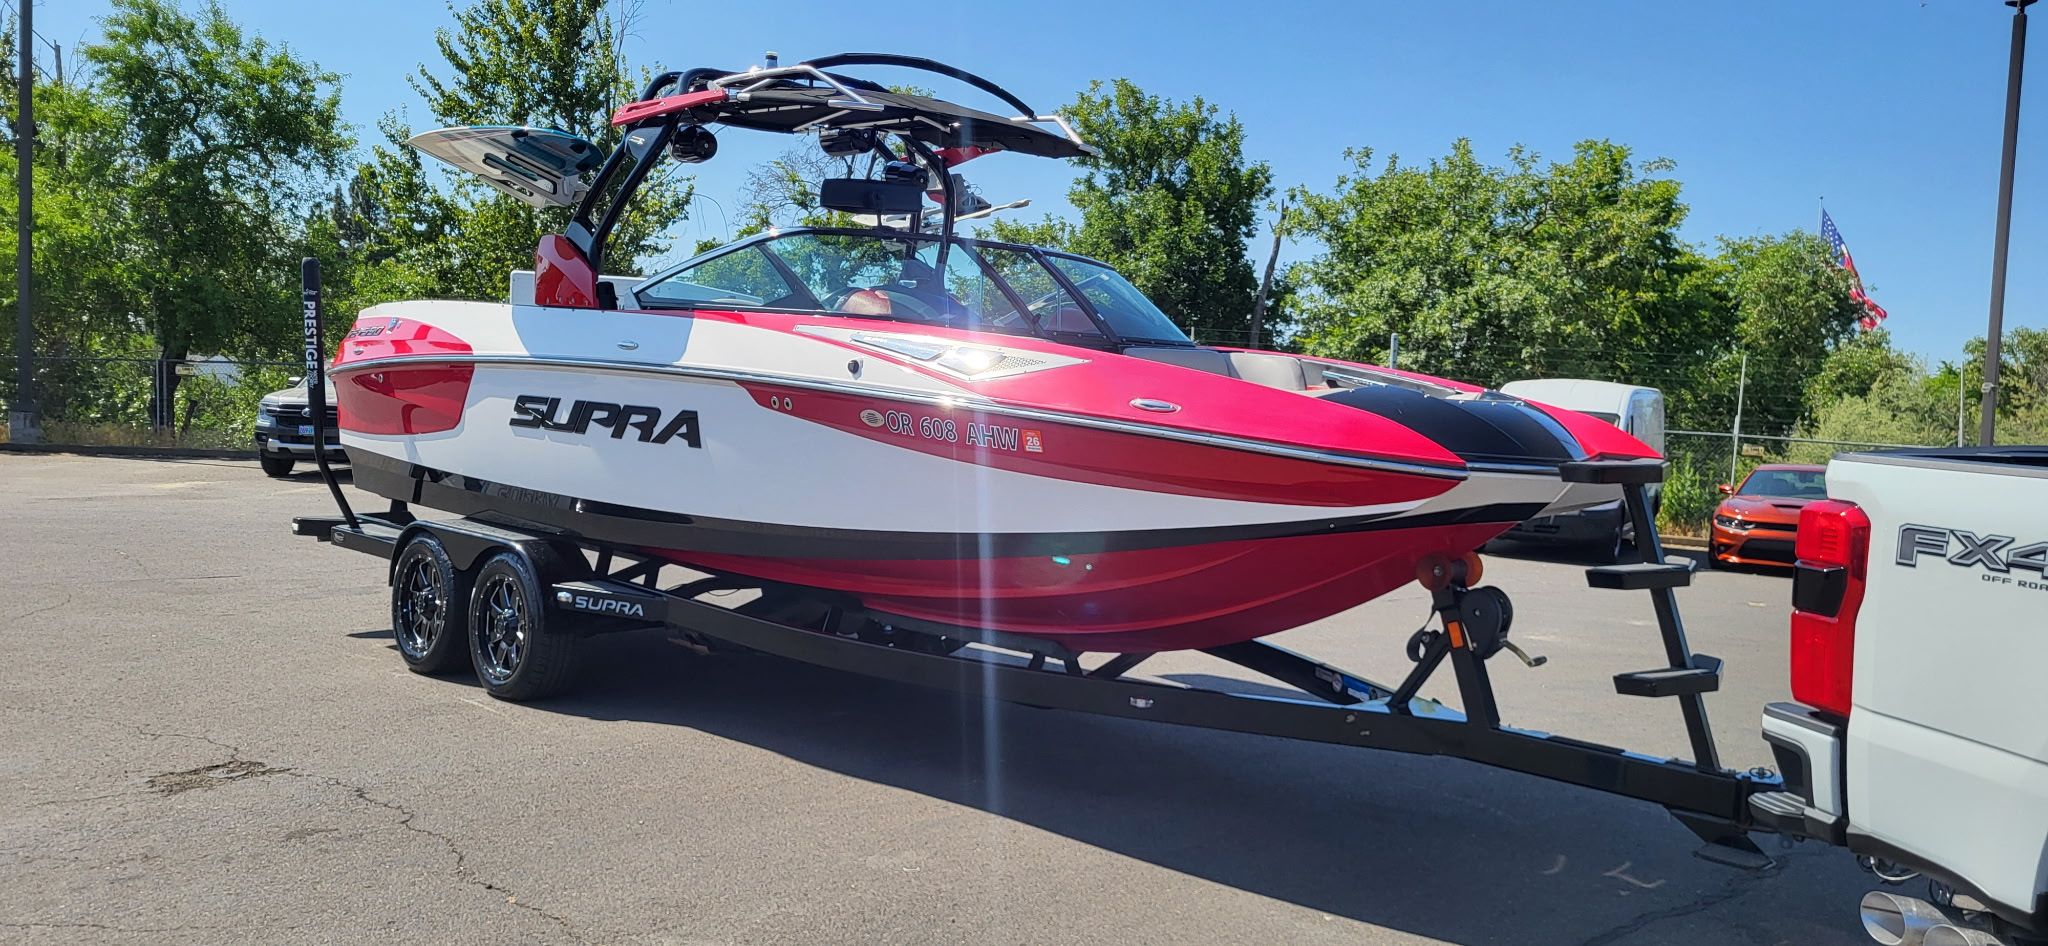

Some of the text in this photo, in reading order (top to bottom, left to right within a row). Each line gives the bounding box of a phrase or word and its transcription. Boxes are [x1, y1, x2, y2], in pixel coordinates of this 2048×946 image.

[303, 301, 318, 369] PRESTIGE
[509, 394, 702, 449] SUPRA
[885, 410, 1019, 451] OR 608 AHW
[1026, 436, 1040, 446] 26
[1895, 523, 2048, 580] FX4
[1981, 574, 2012, 584] OFF
[574, 595, 644, 617] SUPRA
